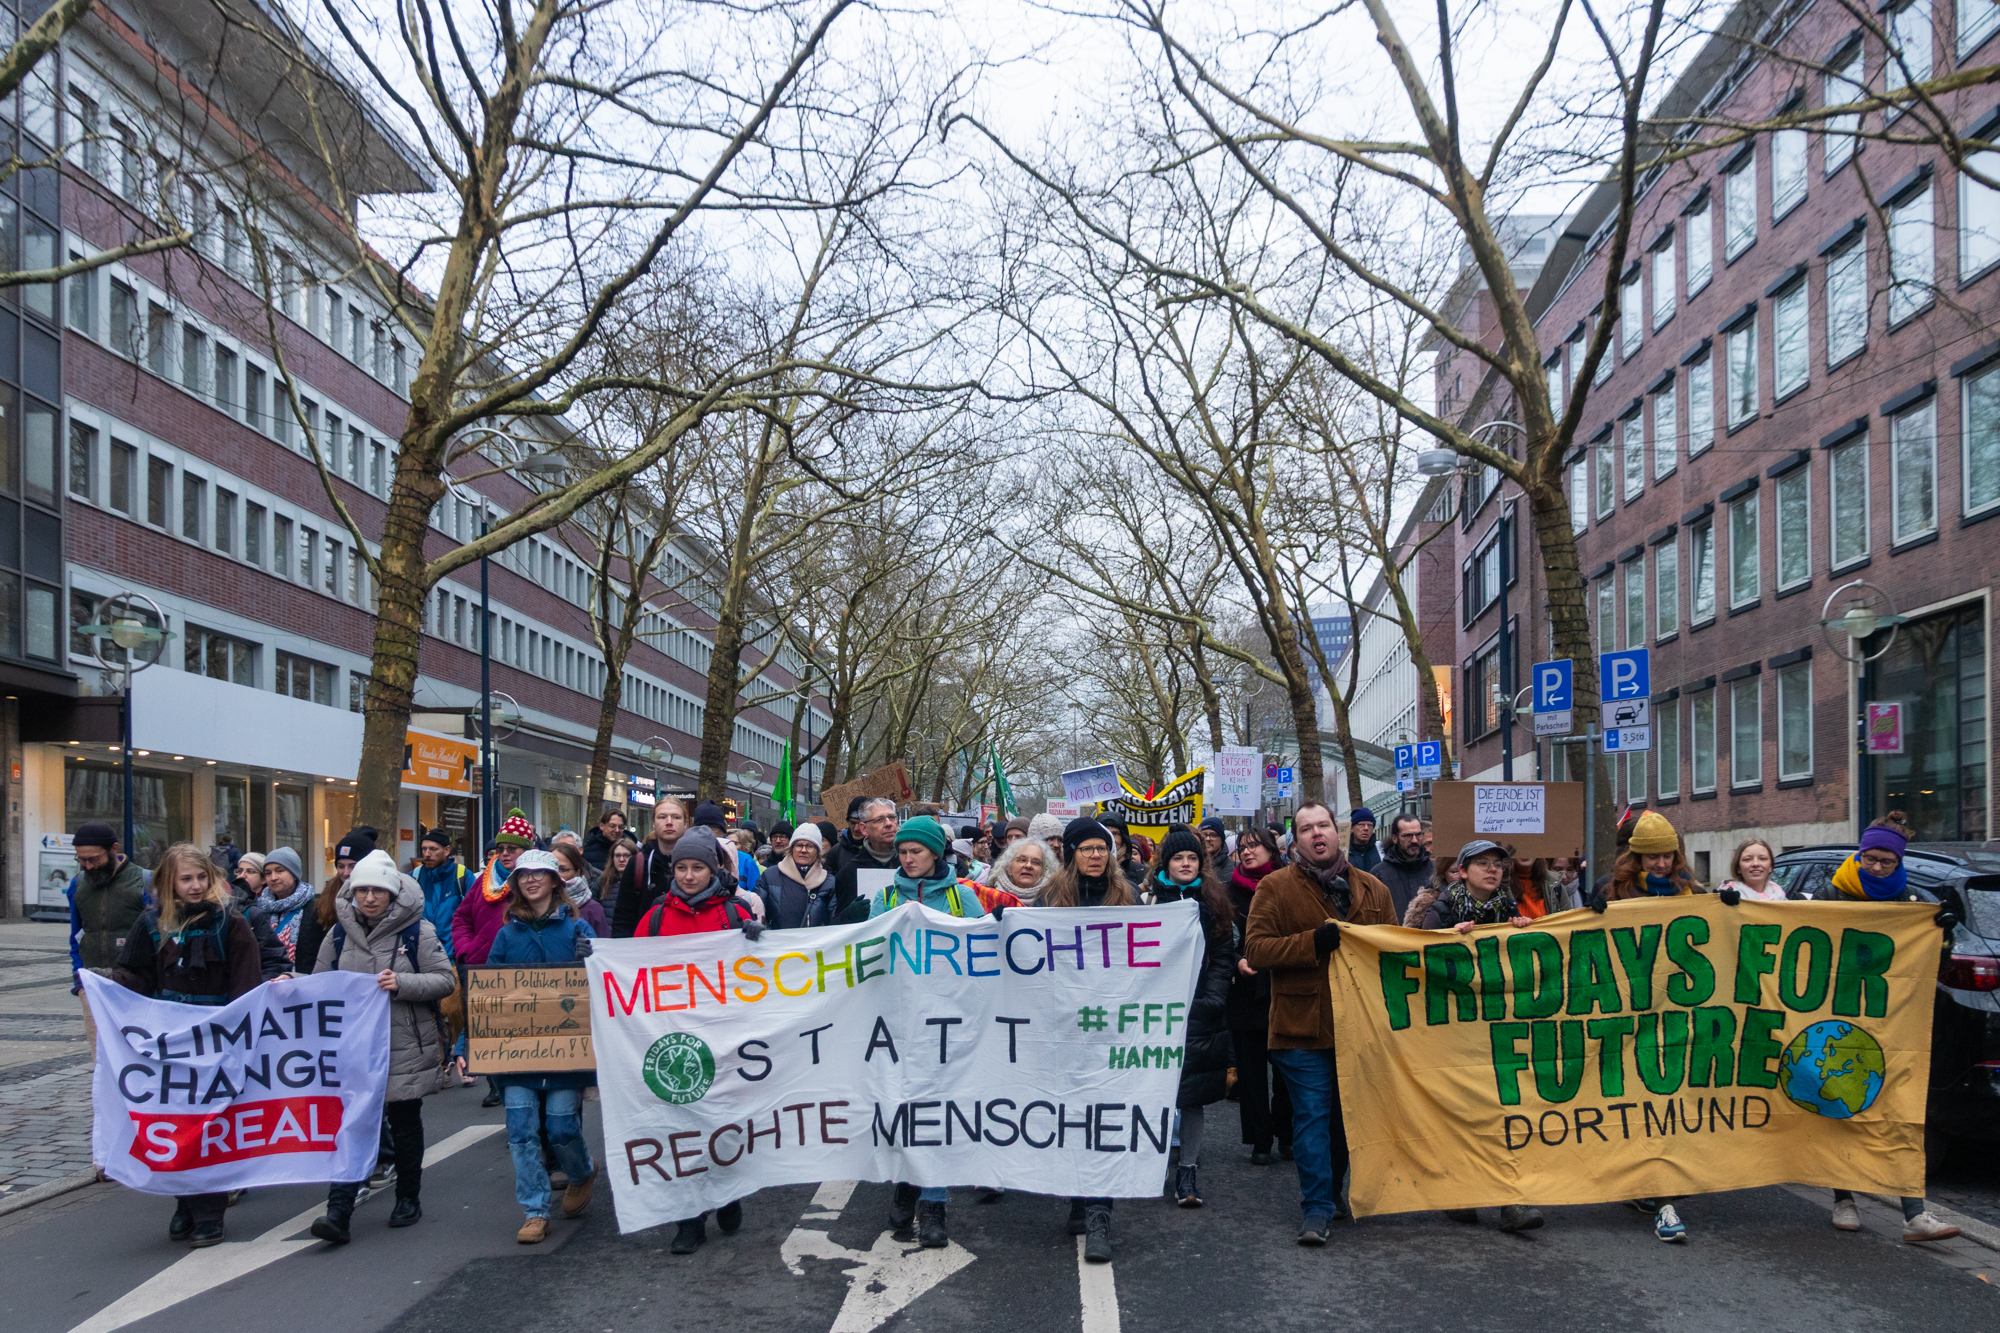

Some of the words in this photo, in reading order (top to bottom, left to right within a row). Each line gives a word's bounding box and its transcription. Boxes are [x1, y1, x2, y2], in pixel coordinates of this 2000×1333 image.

[1542, 668, 1562, 706] P
[1612, 658, 1637, 697] P
[1536, 722, 1569, 731] Parkschein
[1630, 733, 1646, 741] Std.
[1221, 757, 1255, 766] ENTSCHEI-
[1398, 749, 1409, 767] P
[1422, 745, 1434, 764] P
[1221, 768, 1252, 776] DUNGEN
[1281, 770, 1289, 783] P
[1070, 786, 1090, 802] NOT
[1478, 788, 1495, 799] DIE
[1496, 788, 1523, 800] ERDE
[1526, 788, 1543, 800] IST
[1107, 800, 1193, 824] SCHÜTZEN!
[469, 971, 506, 990] Auch
[514, 970, 562, 989] Politiker
[602, 921, 1162, 1018] MENSCHENRECHTE
[1378, 915, 1716, 1032] FRIDAYS
[1734, 923, 1895, 1018] FOR
[470, 995, 508, 1014] NICHT
[513, 993, 540, 1013] mit
[121, 1000, 345, 1060] CLIMATE
[471, 1015, 560, 1043] Naturgesetzen
[1077, 1002, 1186, 1036] #FFF
[645, 1034, 677, 1071] FRIDAYS
[680, 1033, 703, 1050] FOR
[1108, 1045, 1183, 1070] HAMM
[1489, 1006, 1786, 1106] FUTURE
[118, 1050, 341, 1105] CHANGE
[671, 1078, 712, 1103] FUTURE
[200, 1103, 334, 1157] REAL
[1504, 1095, 1771, 1151] DORTMUND
[624, 1100, 850, 1186] RECHTE
[871, 1098, 1170, 1154] MENSCHEN
